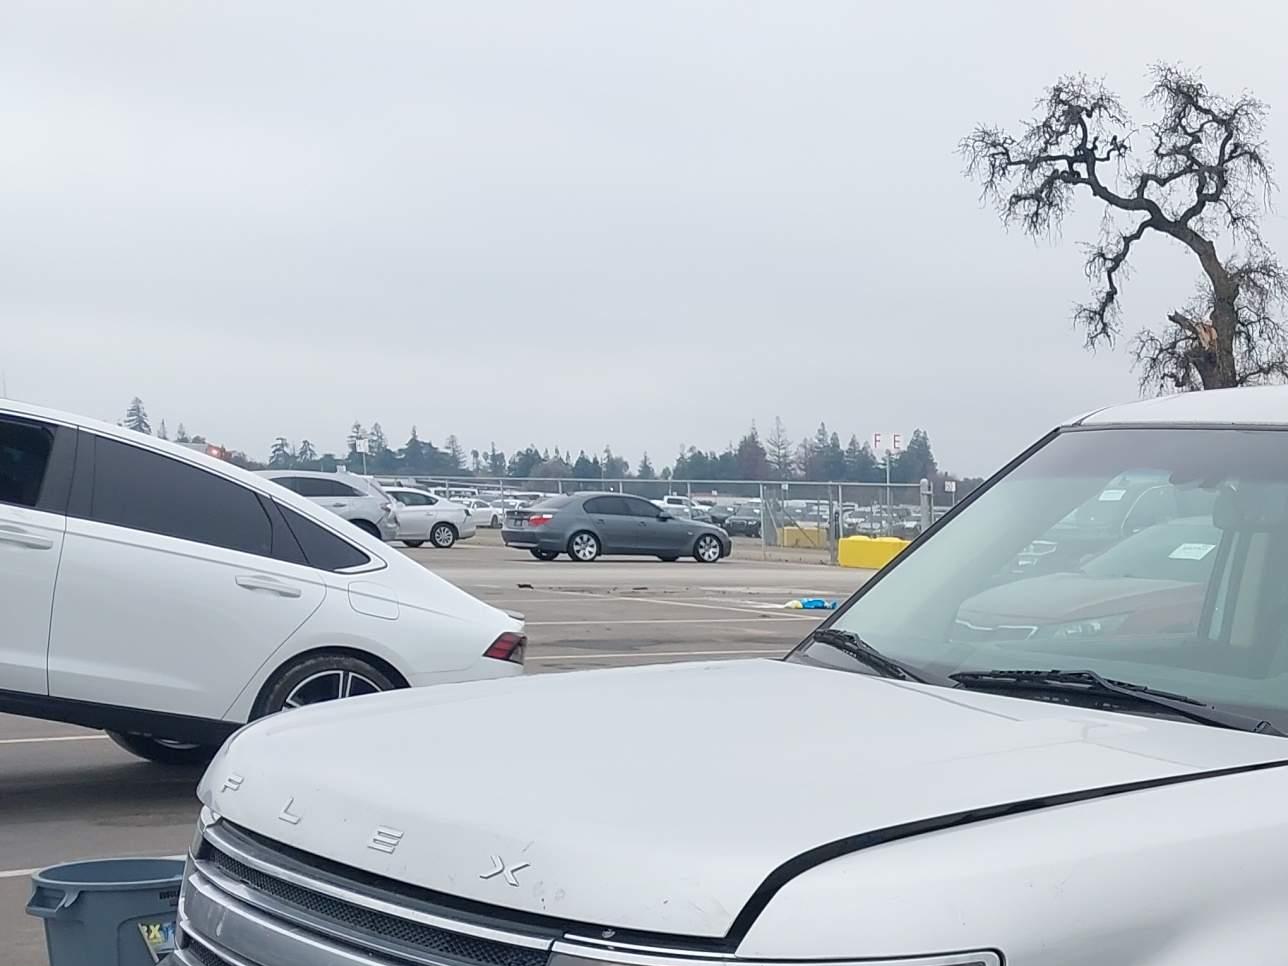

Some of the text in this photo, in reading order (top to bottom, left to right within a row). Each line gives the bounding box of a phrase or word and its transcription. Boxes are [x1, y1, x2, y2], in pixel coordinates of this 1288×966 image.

[874, 433, 881, 449] F
[893, 434, 901, 450] E
[220, 771, 531, 888] FLEX
